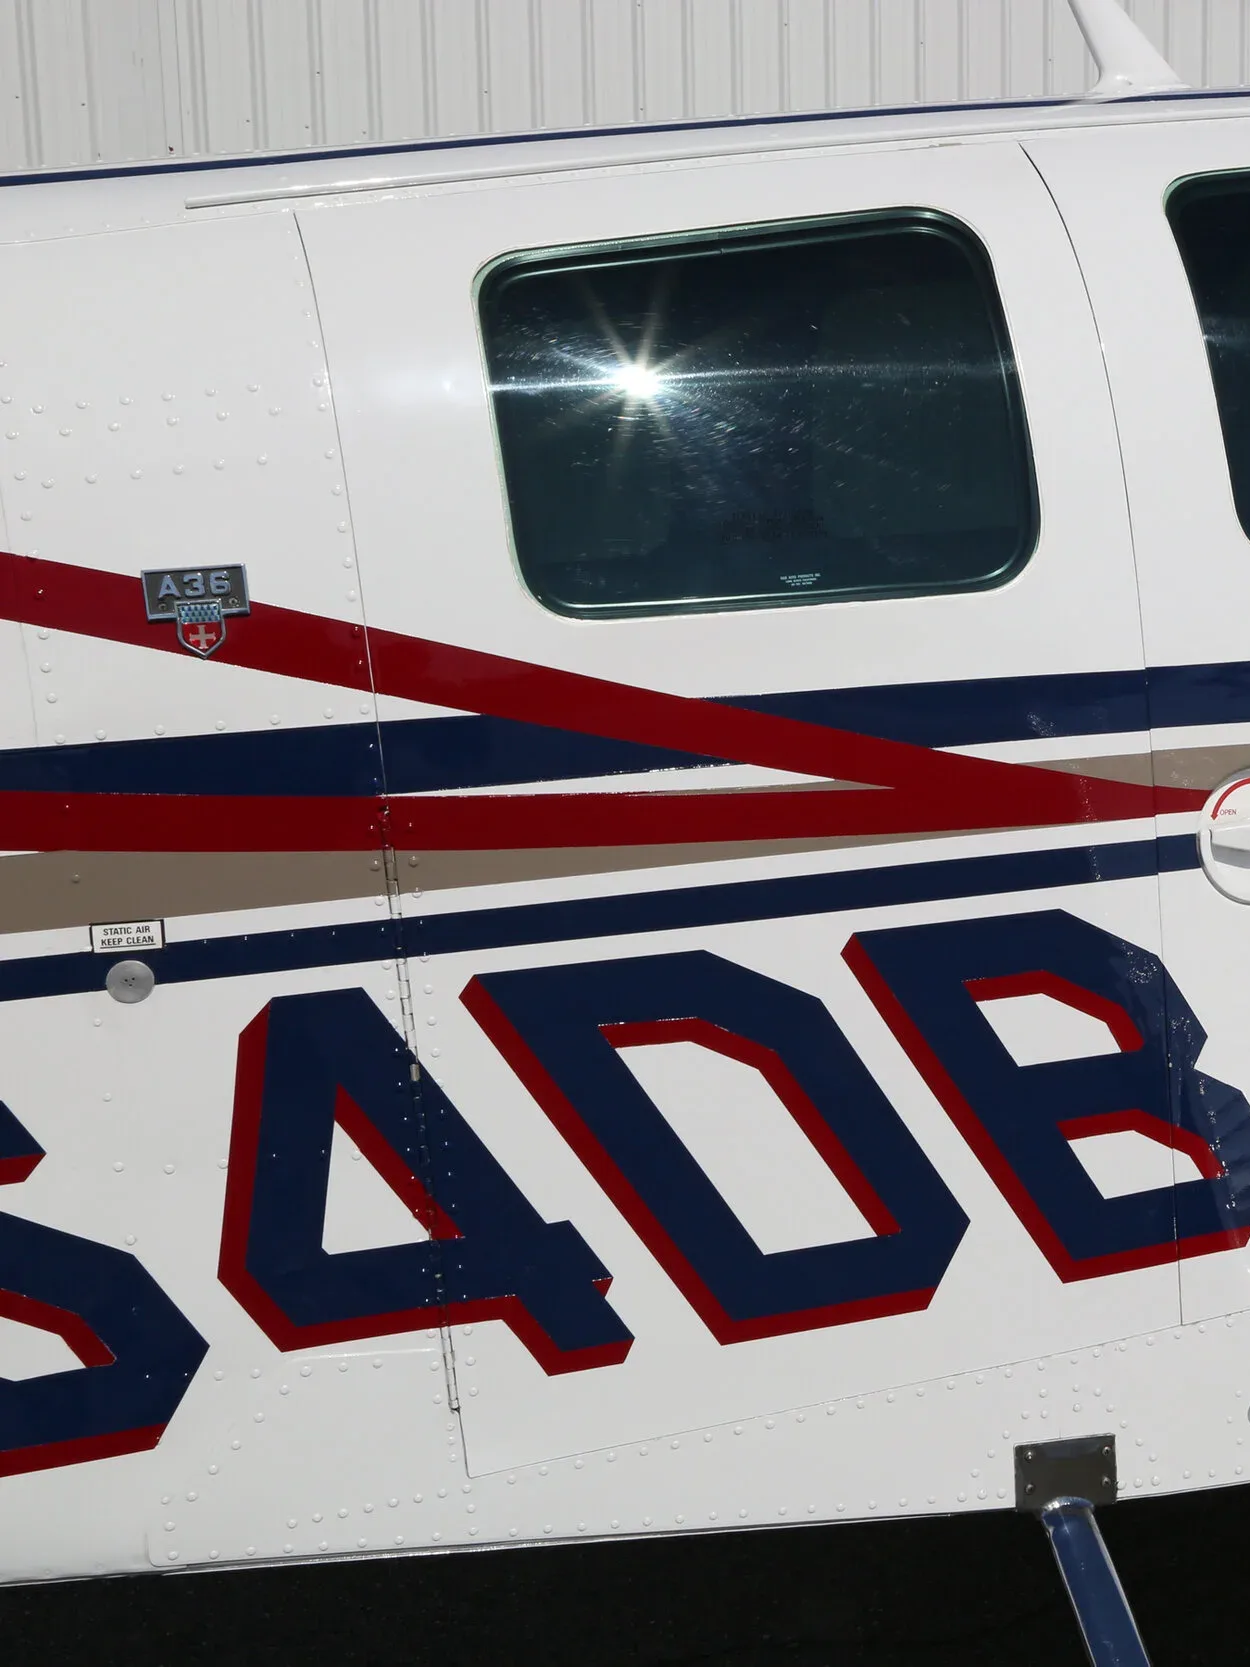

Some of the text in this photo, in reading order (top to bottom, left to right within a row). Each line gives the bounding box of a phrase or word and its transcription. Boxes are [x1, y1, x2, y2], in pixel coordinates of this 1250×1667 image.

[157, 571, 231, 599] A36
[103, 925, 151, 936] STATIC AIR
[101, 935, 154, 946] KEEP CLEAN
